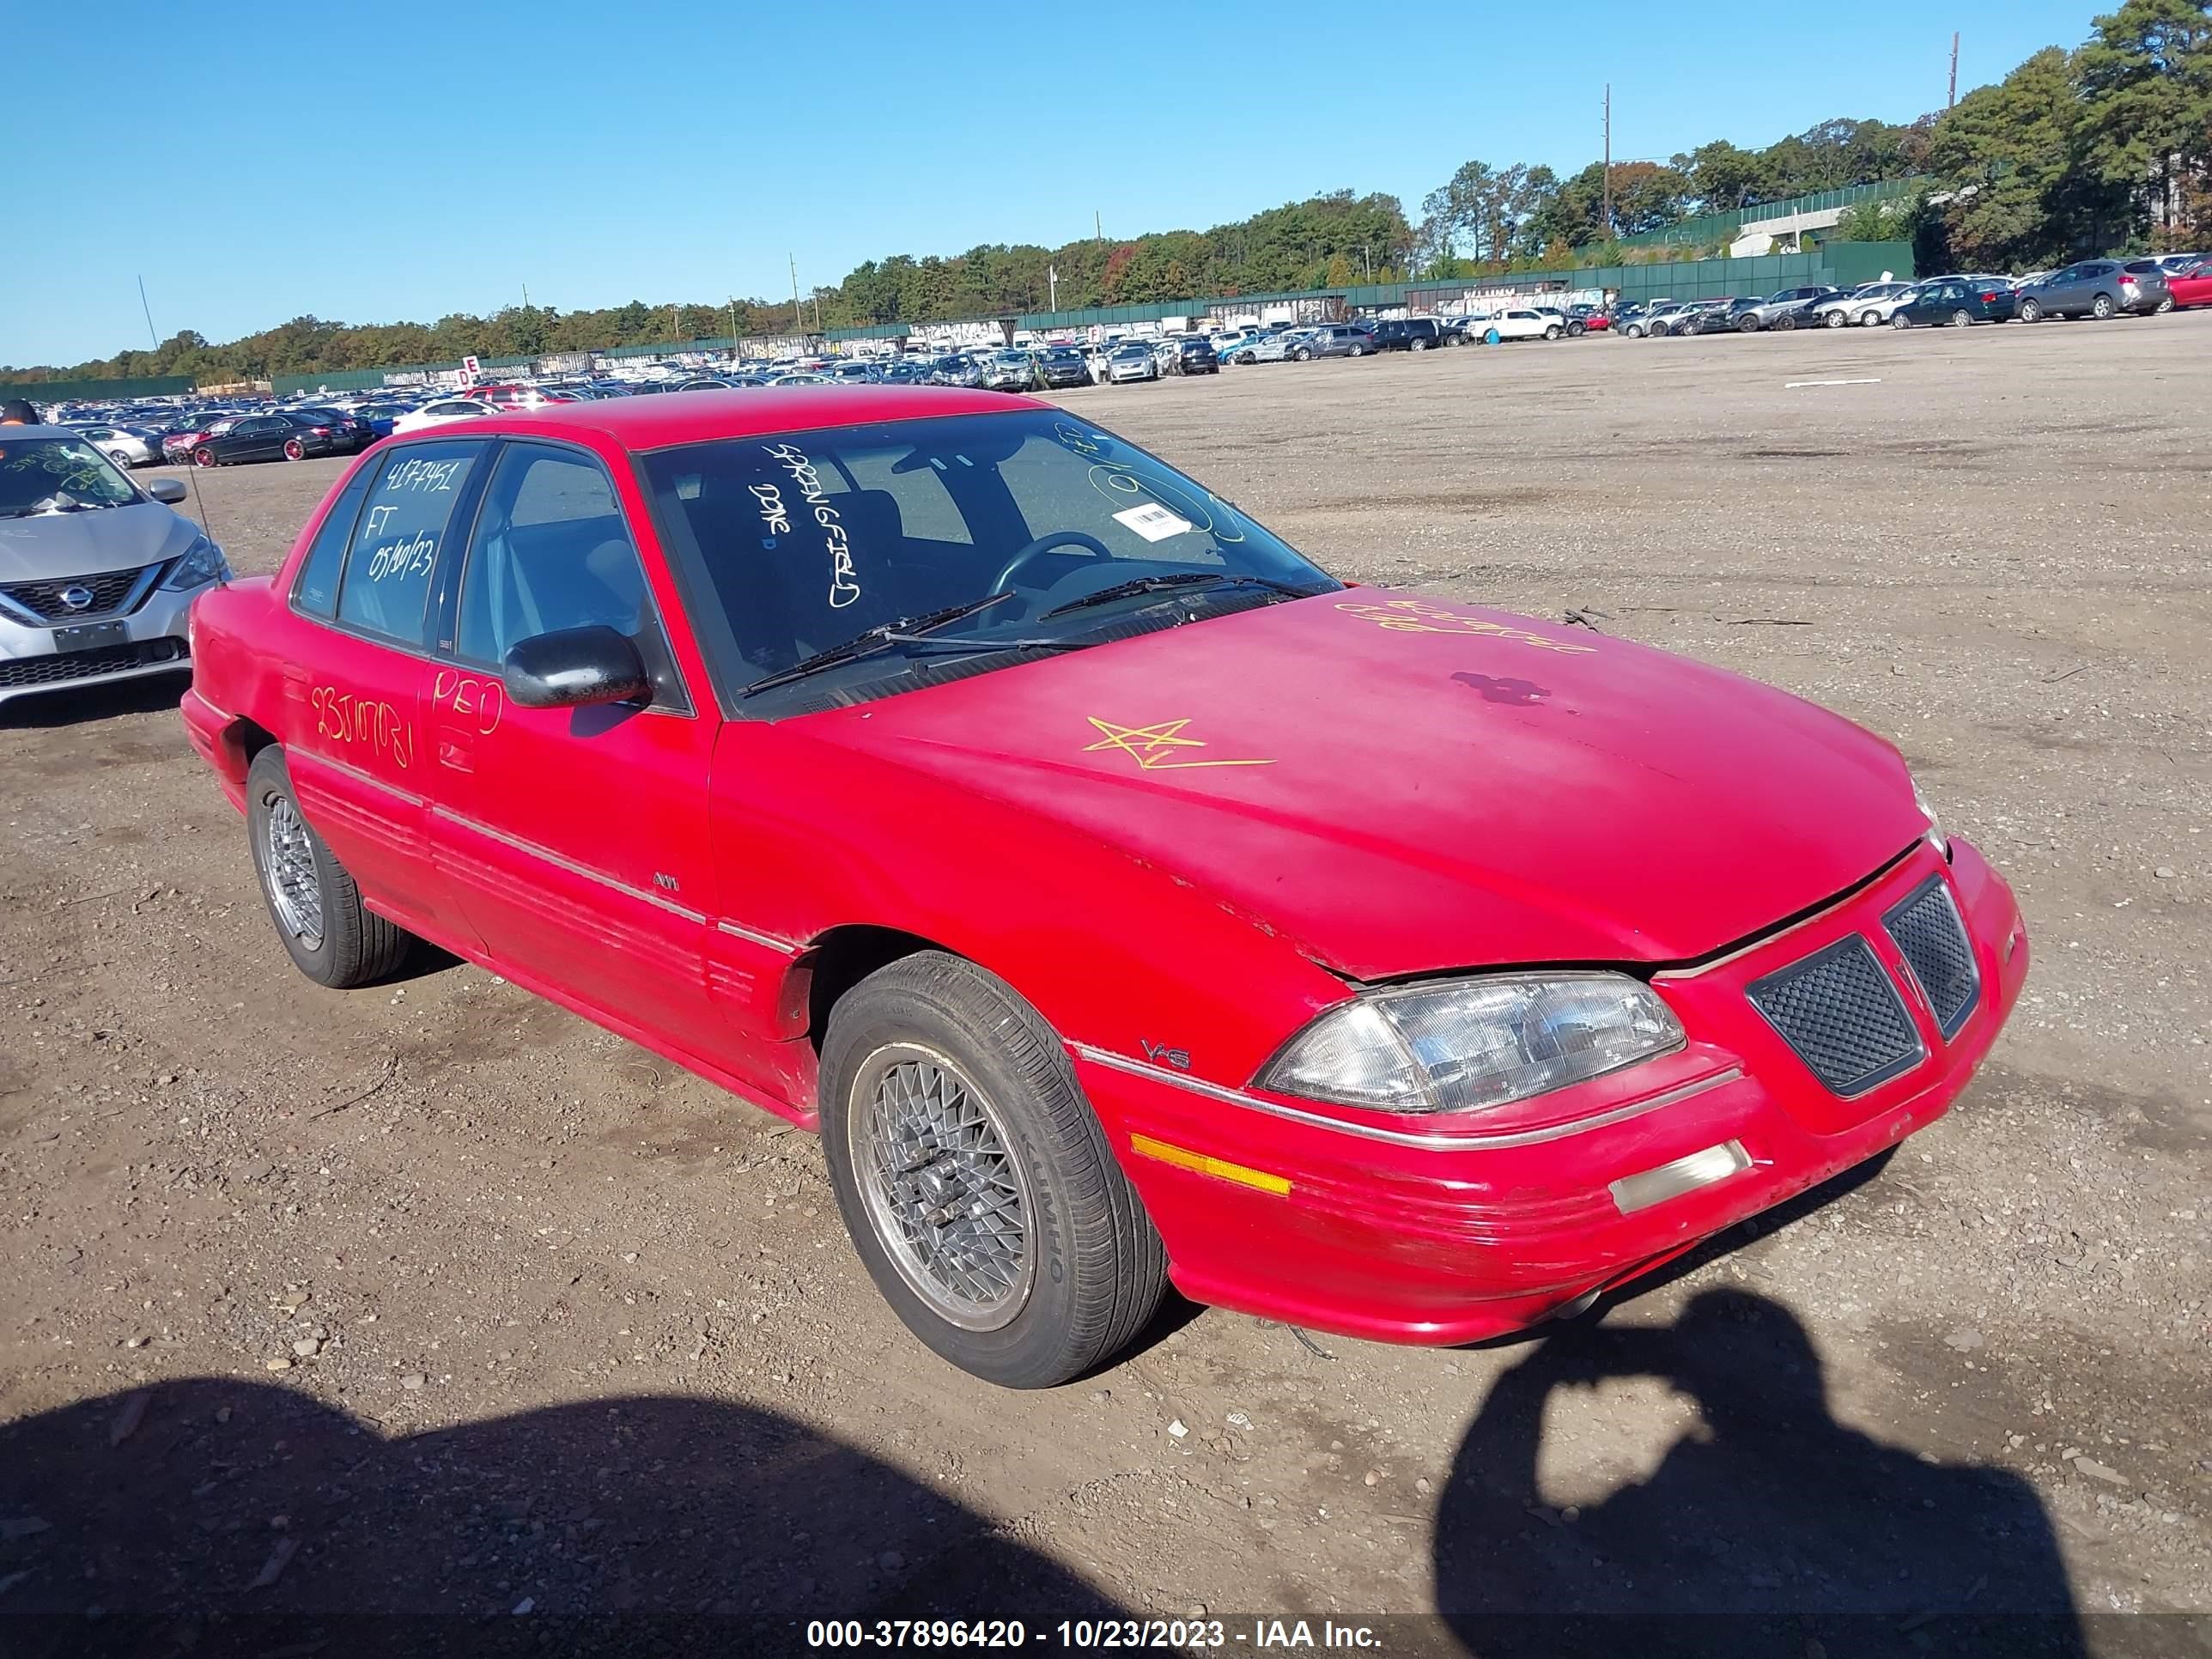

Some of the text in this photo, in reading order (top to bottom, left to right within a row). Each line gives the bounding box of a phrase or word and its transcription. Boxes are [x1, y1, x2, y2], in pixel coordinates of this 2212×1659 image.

[459, 371, 469, 386] D
[466, 359, 477, 372] E
[365, 505, 398, 539] FT
[748, 483, 791, 534] DONE
[1020, 1133, 1064, 1284] KUMHO
